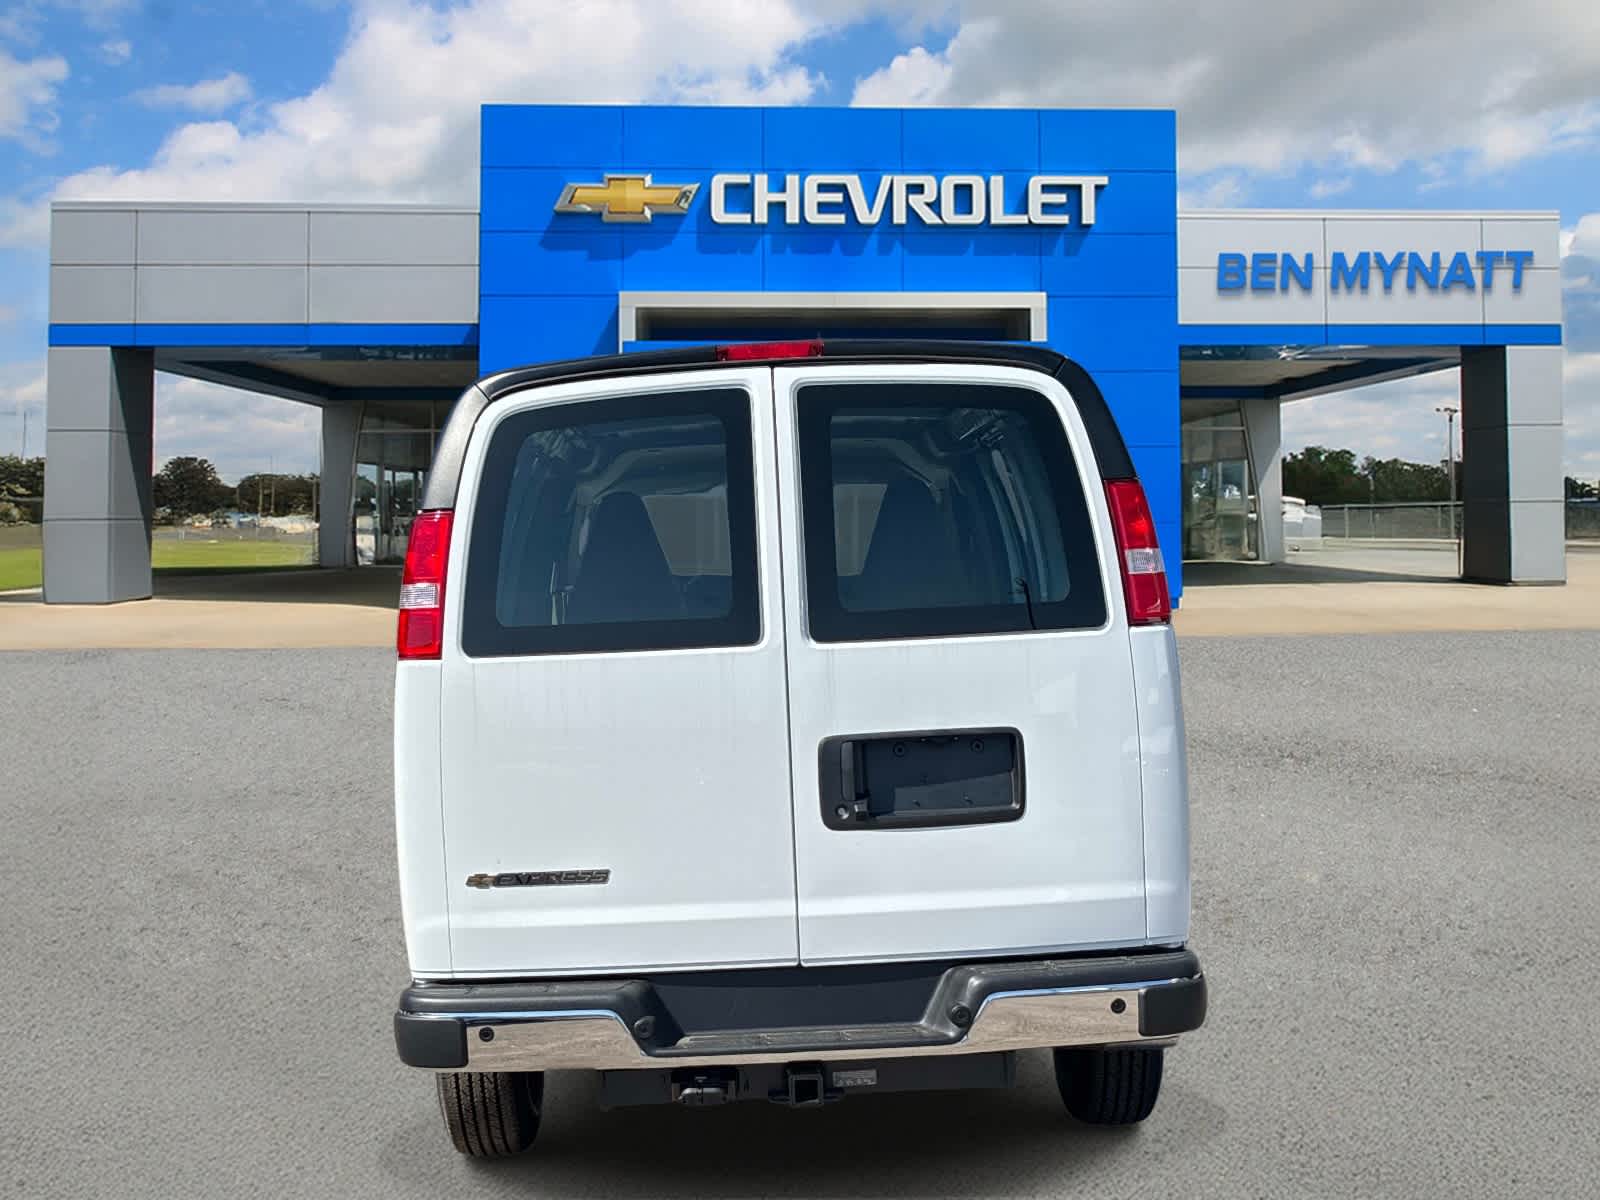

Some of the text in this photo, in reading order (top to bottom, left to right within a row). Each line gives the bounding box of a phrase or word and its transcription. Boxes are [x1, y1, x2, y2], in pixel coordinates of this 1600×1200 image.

[710, 173, 1109, 225] CHEVROLET
[1217, 250, 1534, 291] BEN MYNATT
